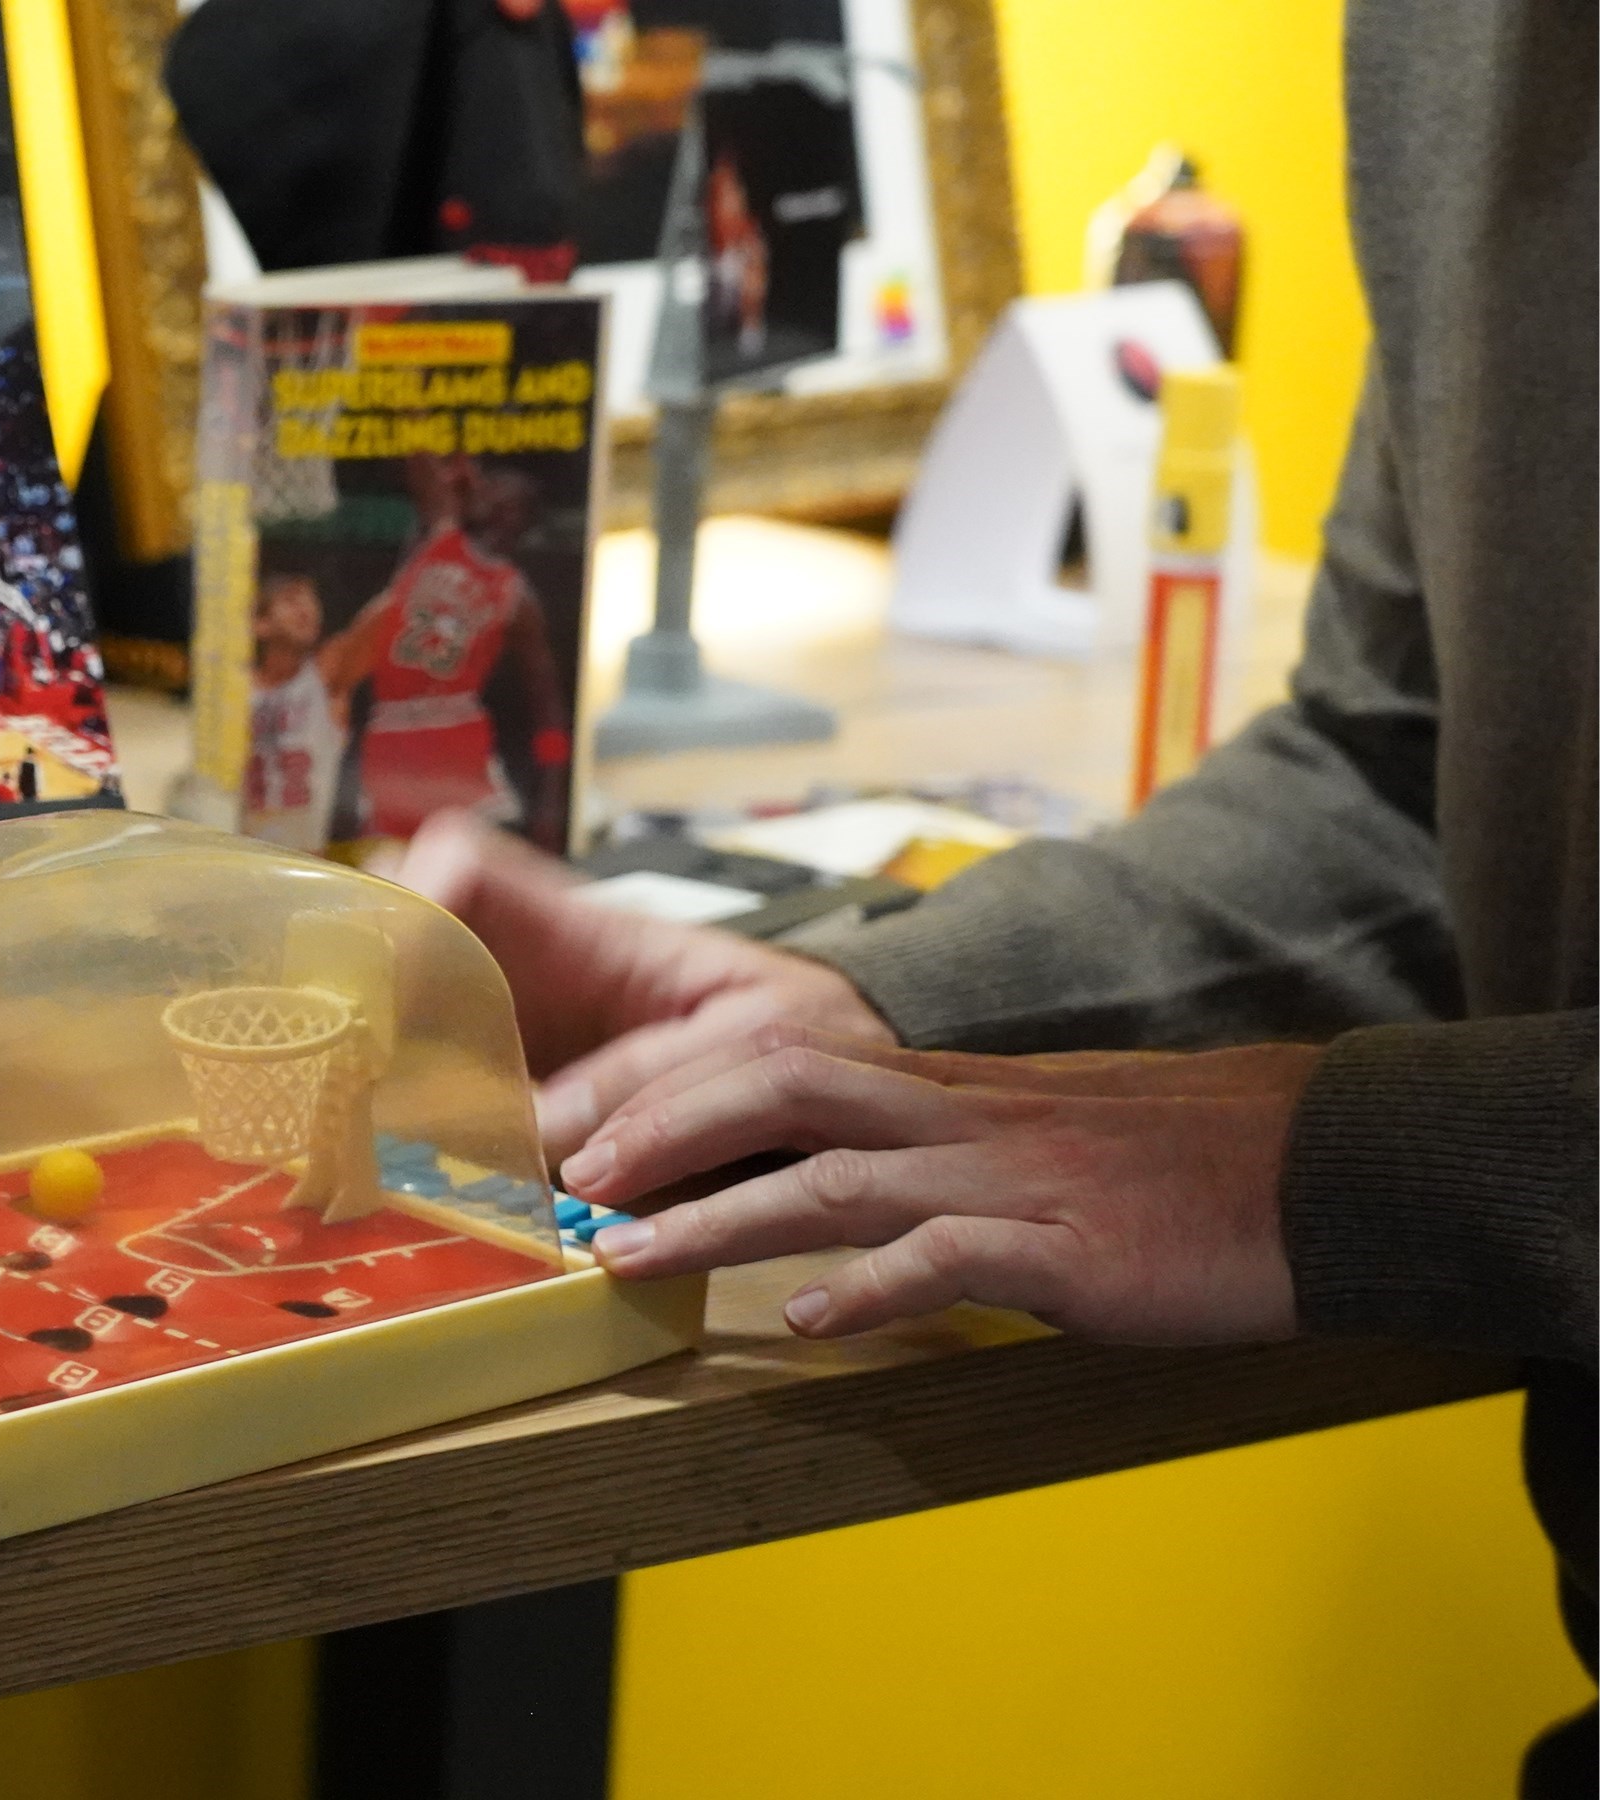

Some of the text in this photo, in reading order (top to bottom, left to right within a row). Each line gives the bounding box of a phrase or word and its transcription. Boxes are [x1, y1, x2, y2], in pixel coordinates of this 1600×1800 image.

[514, 361, 591, 404] AND
[277, 410, 584, 458] DAZZLING DUNKS
[150, 1271, 189, 1295] 5
[79, 1307, 117, 1331] 6
[54, 1363, 92, 1386] 8
